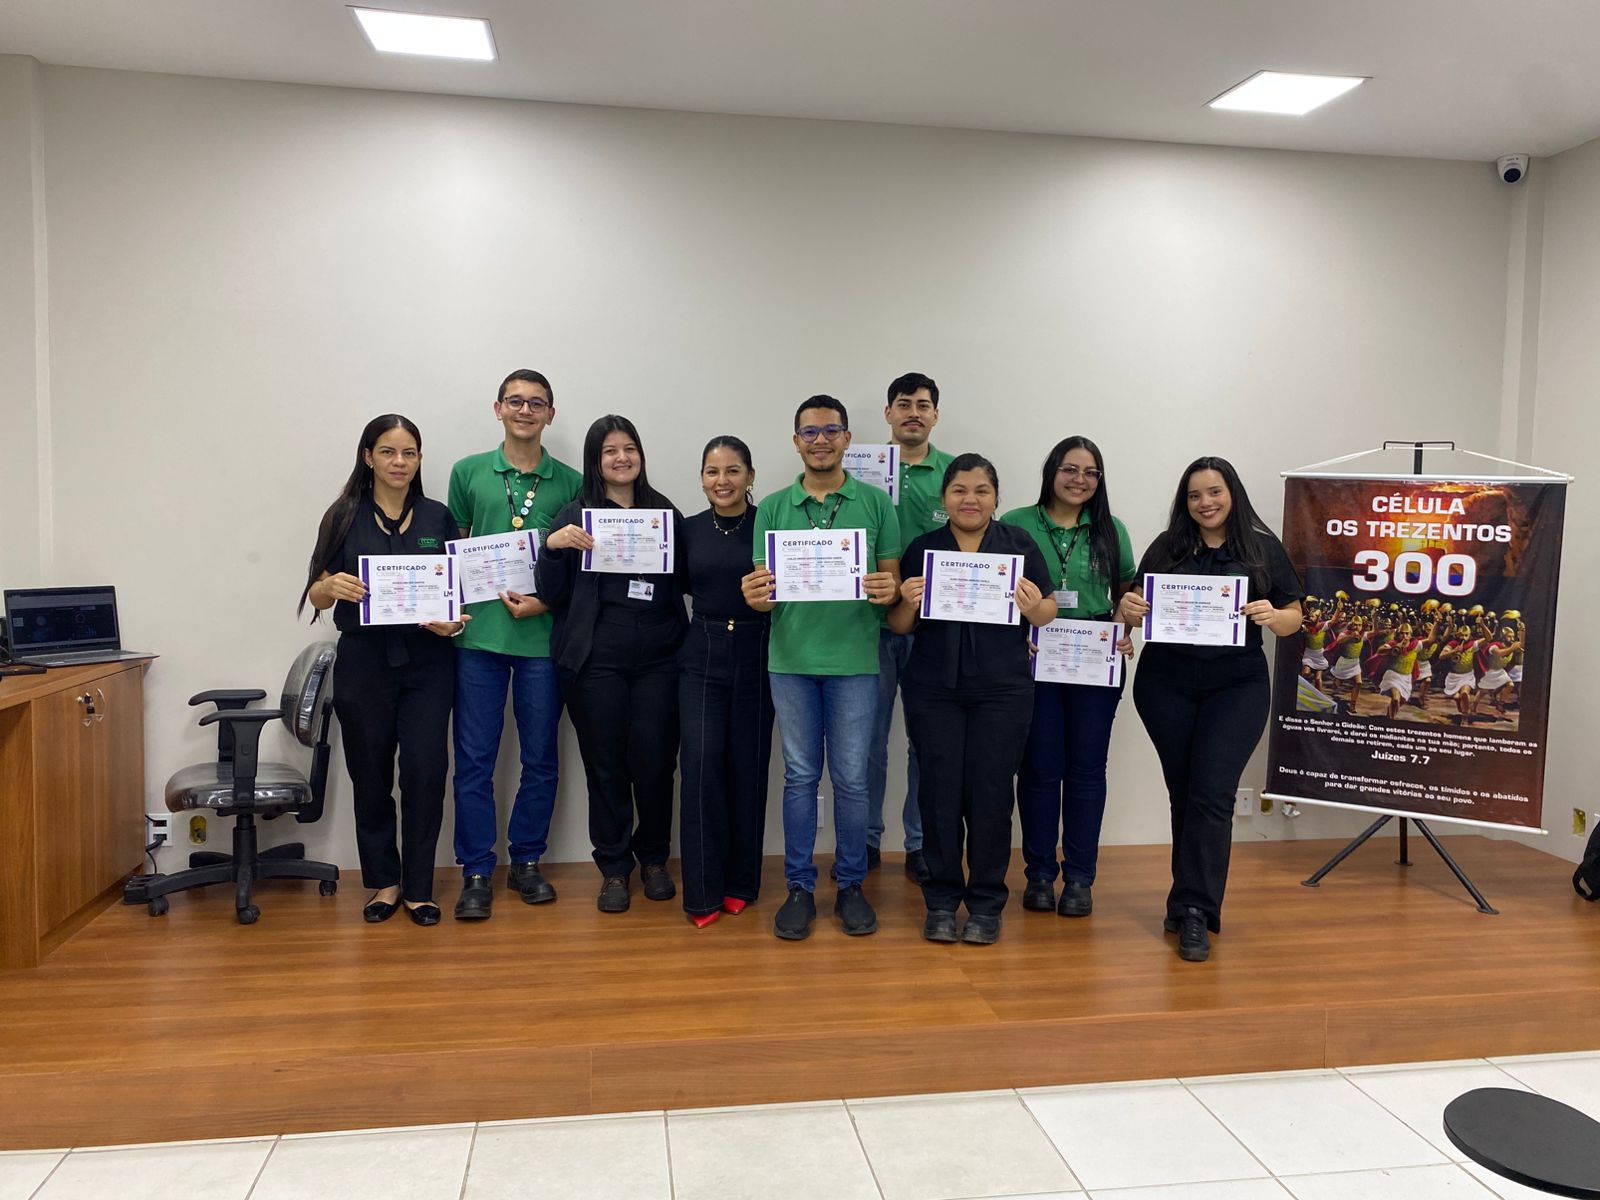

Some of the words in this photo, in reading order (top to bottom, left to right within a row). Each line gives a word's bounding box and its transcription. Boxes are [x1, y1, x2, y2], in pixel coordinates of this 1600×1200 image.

[1372, 492, 1466, 515] CÉLULA
[1326, 520, 1358, 536] OS
[1366, 520, 1512, 542] TREZENTOS
[462, 542, 510, 554] CERTIFICADO
[1352, 550, 1476, 596] 300
[1046, 627, 1092, 635] CERTIFICADO
[1342, 722, 1366, 730] Gideão:
[1408, 729, 1441, 738] trezentos
[1444, 732, 1472, 740] homens
[1489, 737, 1526, 746] lamberam
[1366, 740, 1394, 748] retirem,
[1454, 748, 1476, 757] lugar.
[1462, 742, 1497, 752] portanto,
[1371, 750, 1406, 762] Juízes
[1410, 754, 1430, 764] 7.7
[1279, 766, 1298, 774] Deus
[1340, 774, 1388, 784] transformar
[1440, 786, 1470, 796] tímidos
[1492, 793, 1528, 802] abatidos
[1360, 785, 1391, 794] grandes
[1393, 788, 1422, 798] vitórias
[1453, 796, 1475, 804] povo.
